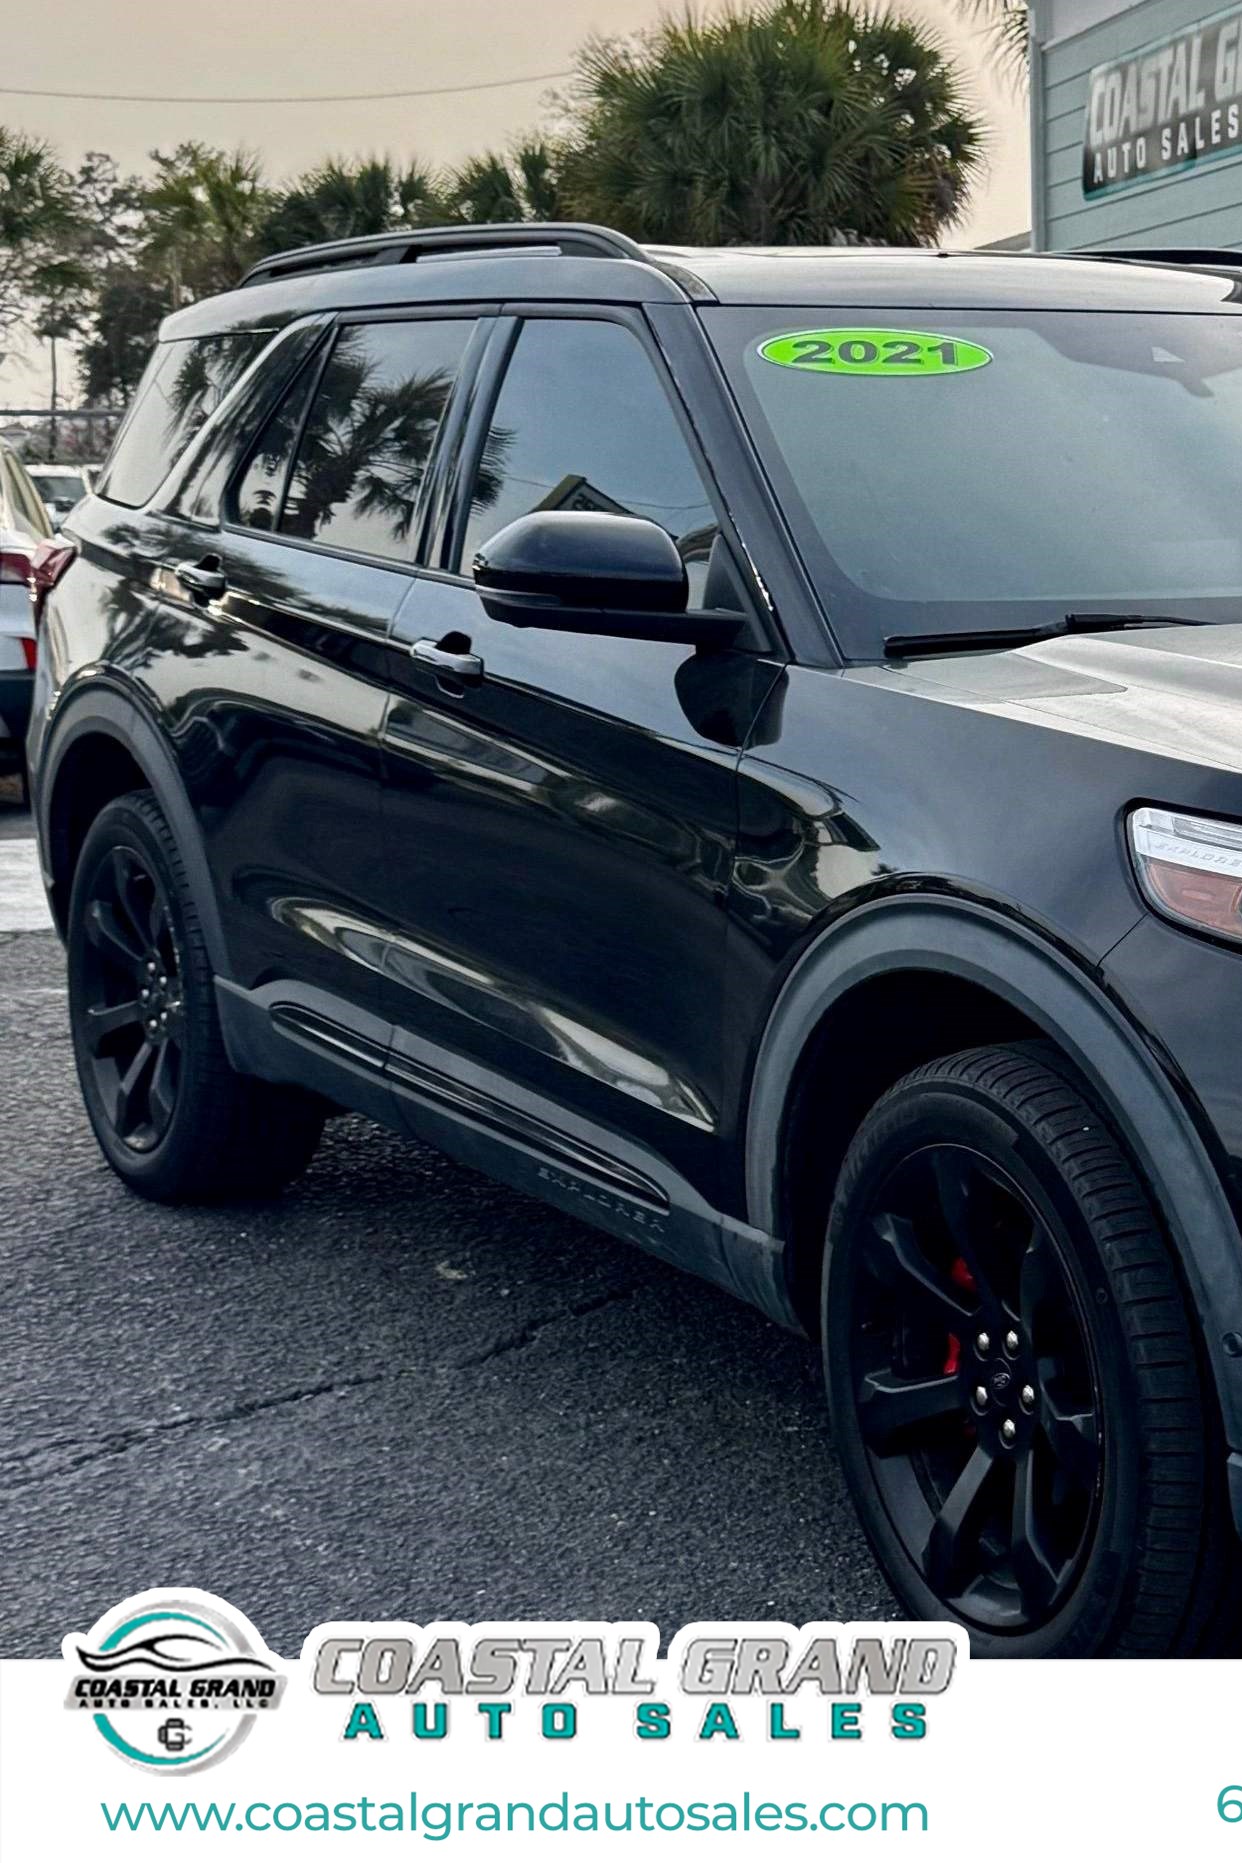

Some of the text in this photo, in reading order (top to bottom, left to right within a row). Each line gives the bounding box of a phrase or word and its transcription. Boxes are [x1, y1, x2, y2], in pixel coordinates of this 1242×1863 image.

[1090, 36, 1205, 147] COASTAL
[1094, 137, 1147, 184] AUTO
[791, 340, 958, 366] 2021
